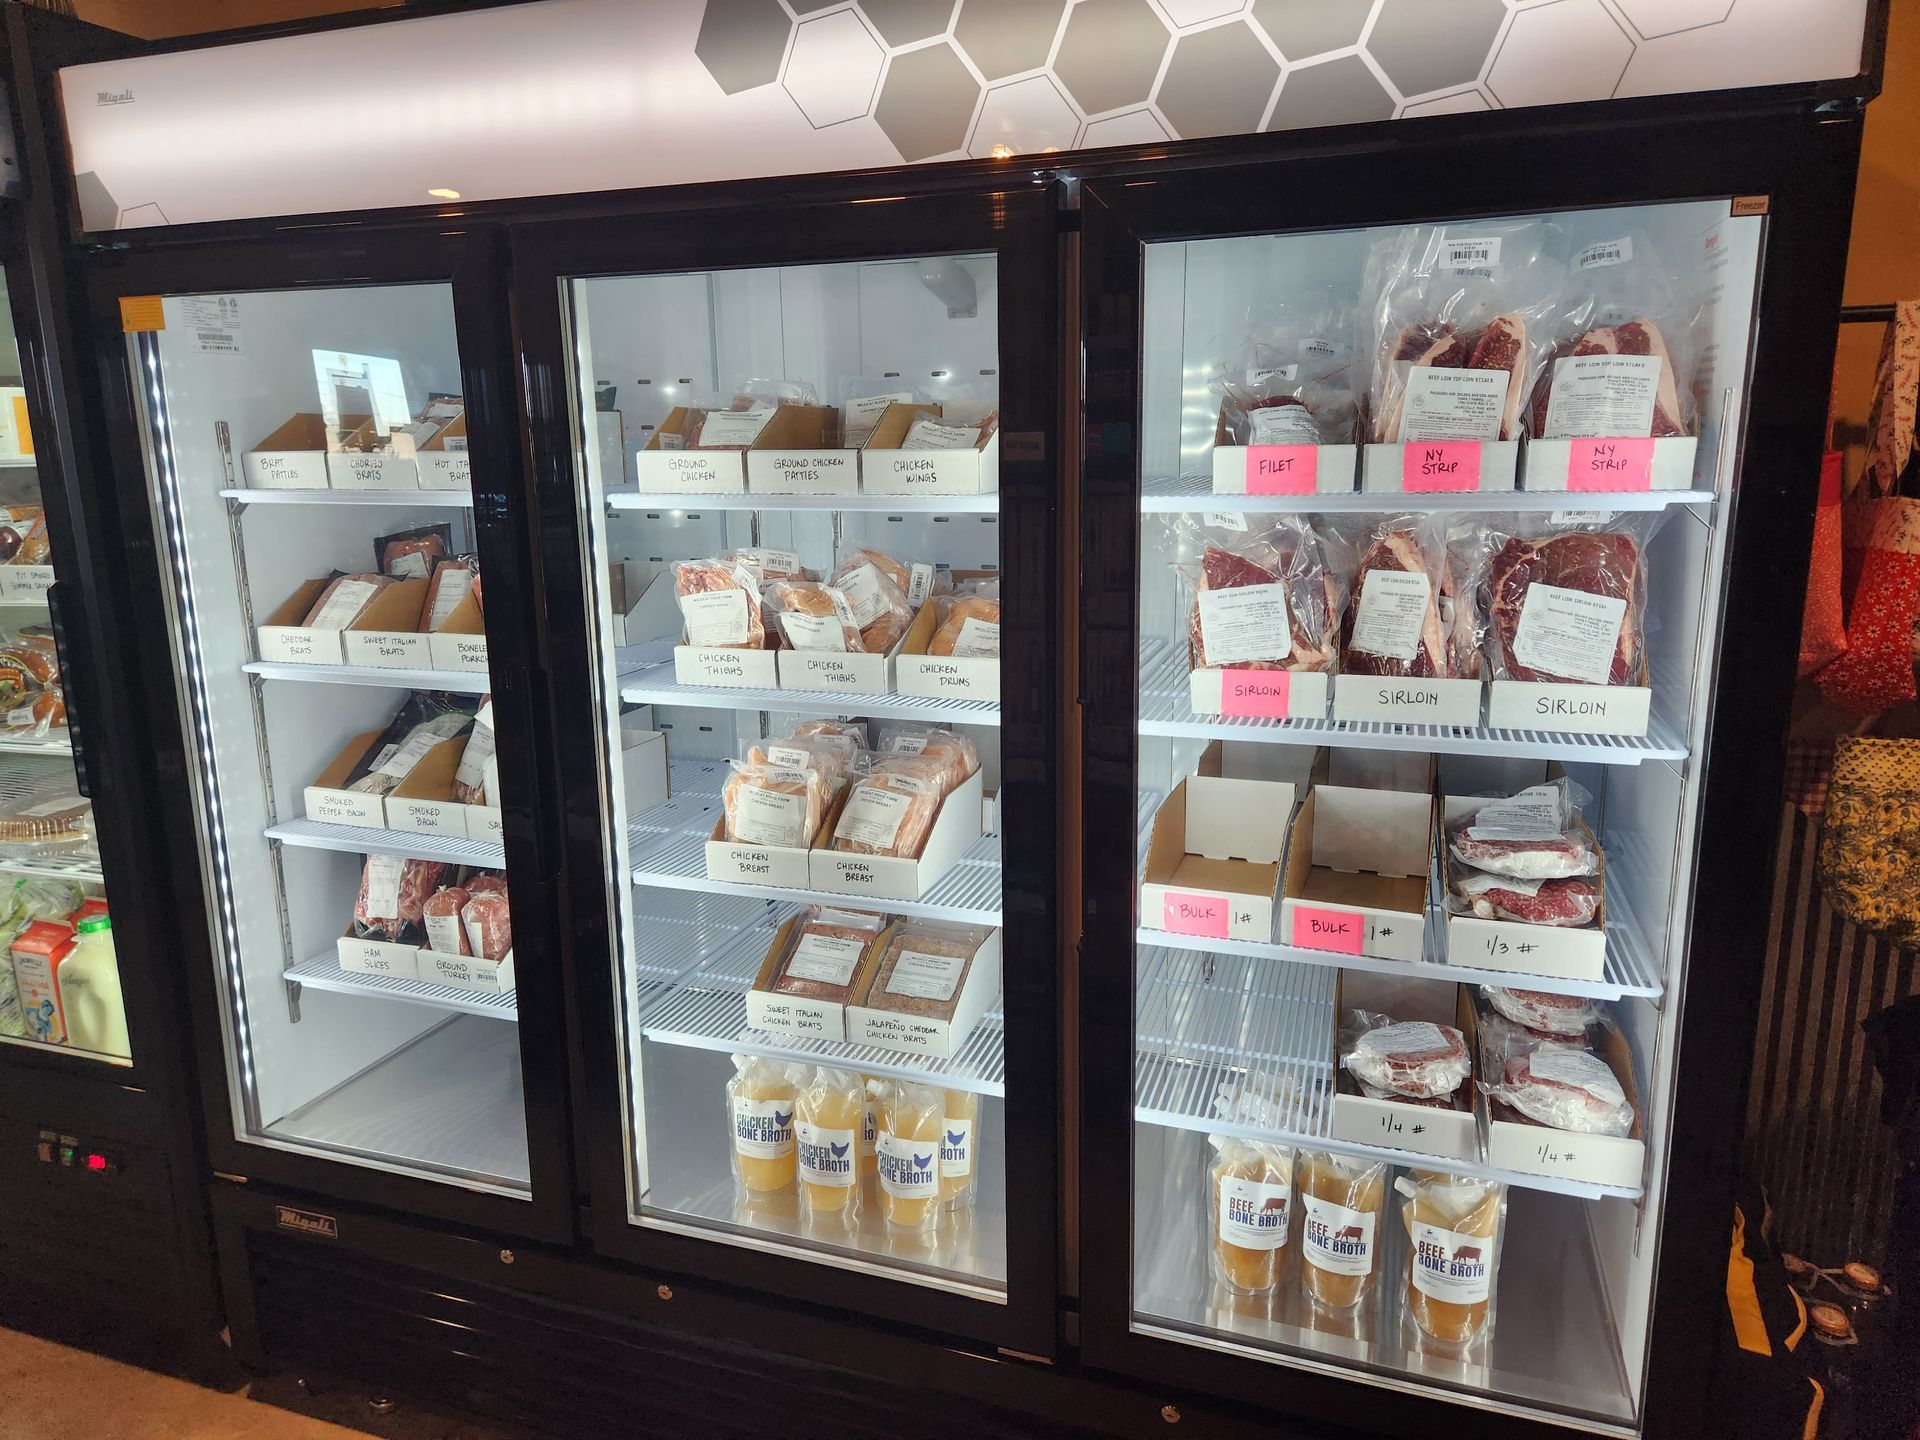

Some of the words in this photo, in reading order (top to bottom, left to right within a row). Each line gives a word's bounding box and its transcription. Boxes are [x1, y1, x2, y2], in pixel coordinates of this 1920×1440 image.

[97, 89, 135, 105] Migali
[1736, 201, 1766, 210] Freezer
[1425, 448, 1444, 462] NY
[1593, 444, 1616, 458] NY
[261, 458, 284, 470] BRAT
[350, 459, 383, 469] CHORIZO
[435, 459, 450, 470] HOT
[668, 459, 708, 471] GROUND
[773, 458, 808, 470] GROUND
[812, 458, 845, 467] CHICKEN
[893, 458, 934, 473] CHICKEN
[1259, 457, 1295, 475] FILET
[1422, 462, 1459, 475] STRIP
[1591, 459, 1628, 471] STRIP
[271, 470, 299, 480] PATTIES
[356, 470, 382, 481] BRATS
[680, 471, 716, 483] CHICKEN
[784, 470, 819, 482] PATTIES
[905, 472, 937, 484] WINGS
[280, 634, 313, 645] CHEDDAR
[363, 635, 387, 645] SWEET
[391, 637, 417, 646] ITALIAN
[290, 646, 313, 656] BRATS
[379, 646, 405, 657] BRATS
[698, 653, 741, 664] CHICKEN
[704, 666, 743, 676] THIGHS
[807, 660, 844, 671] CHICKEN
[919, 663, 958, 674] CHICKEN
[824, 673, 857, 684] THIGHS
[939, 676, 971, 687] DRUMS
[1234, 684, 1281, 697] SIRLOIN
[1377, 689, 1439, 706] SIRLOIN
[1535, 696, 1607, 716] SIRLOIN
[324, 796, 354, 806] SMOKED
[318, 806, 343, 816] PEPPER
[346, 808, 366, 817] BACON
[408, 806, 441, 816] SMOKED
[415, 816, 438, 827] BACON
[730, 851, 769, 862] CHICKEN
[737, 862, 771, 874] BREAST
[836, 862, 870, 872] CHICKEN
[844, 872, 874, 883] BREAST
[1180, 903, 1217, 919] BULK
[1311, 918, 1350, 934] BULK
[1486, 934, 1510, 957] 1/3
[1516, 943, 1540, 954] #
[364, 948, 382, 958] HAM
[364, 959, 390, 970] SLICES
[436, 959, 468, 972] GROUND
[441, 970, 472, 982] TURKEY
[766, 1004, 791, 1016] SWEET
[795, 1008, 823, 1019] ITALIAN
[762, 1015, 791, 1026] CHICKEN
[797, 1020, 823, 1031] BRATS
[865, 1017, 906, 1031] JALAPEÑO
[909, 1024, 940, 1035] CHEDDAR
[866, 1030, 899, 1041] CHICKEN
[901, 1034, 927, 1045] BRATS
[736, 1113, 774, 1130] CHICKEN
[1381, 1112, 1403, 1134] 1/4
[1412, 1124, 1427, 1135] #
[737, 1124, 758, 1141] BONE
[760, 1128, 792, 1143] BROTH
[940, 1147, 966, 1161] ROTH
[1537, 1142, 1558, 1164] 1/4
[1563, 1151, 1577, 1162] #
[818, 1158, 850, 1173] BROTH
[877, 1150, 913, 1173] CHICKEN
[879, 1165, 897, 1183] BONE
[899, 1170, 933, 1185] BROTH
[1229, 1196, 1254, 1213] BEEF
[280, 1209, 335, 1234] Migali
[1228, 1209, 1255, 1227] BONE
[1258, 1213, 1288, 1228] BROTH
[1307, 1217, 1329, 1236] BEEF
[1306, 1229, 1329, 1250] BONE
[1332, 1240, 1367, 1256] BROTH
[1418, 1239, 1445, 1260] BEEF
[1418, 1253, 1446, 1274] BONE
[1450, 1263, 1485, 1278] BROTH
